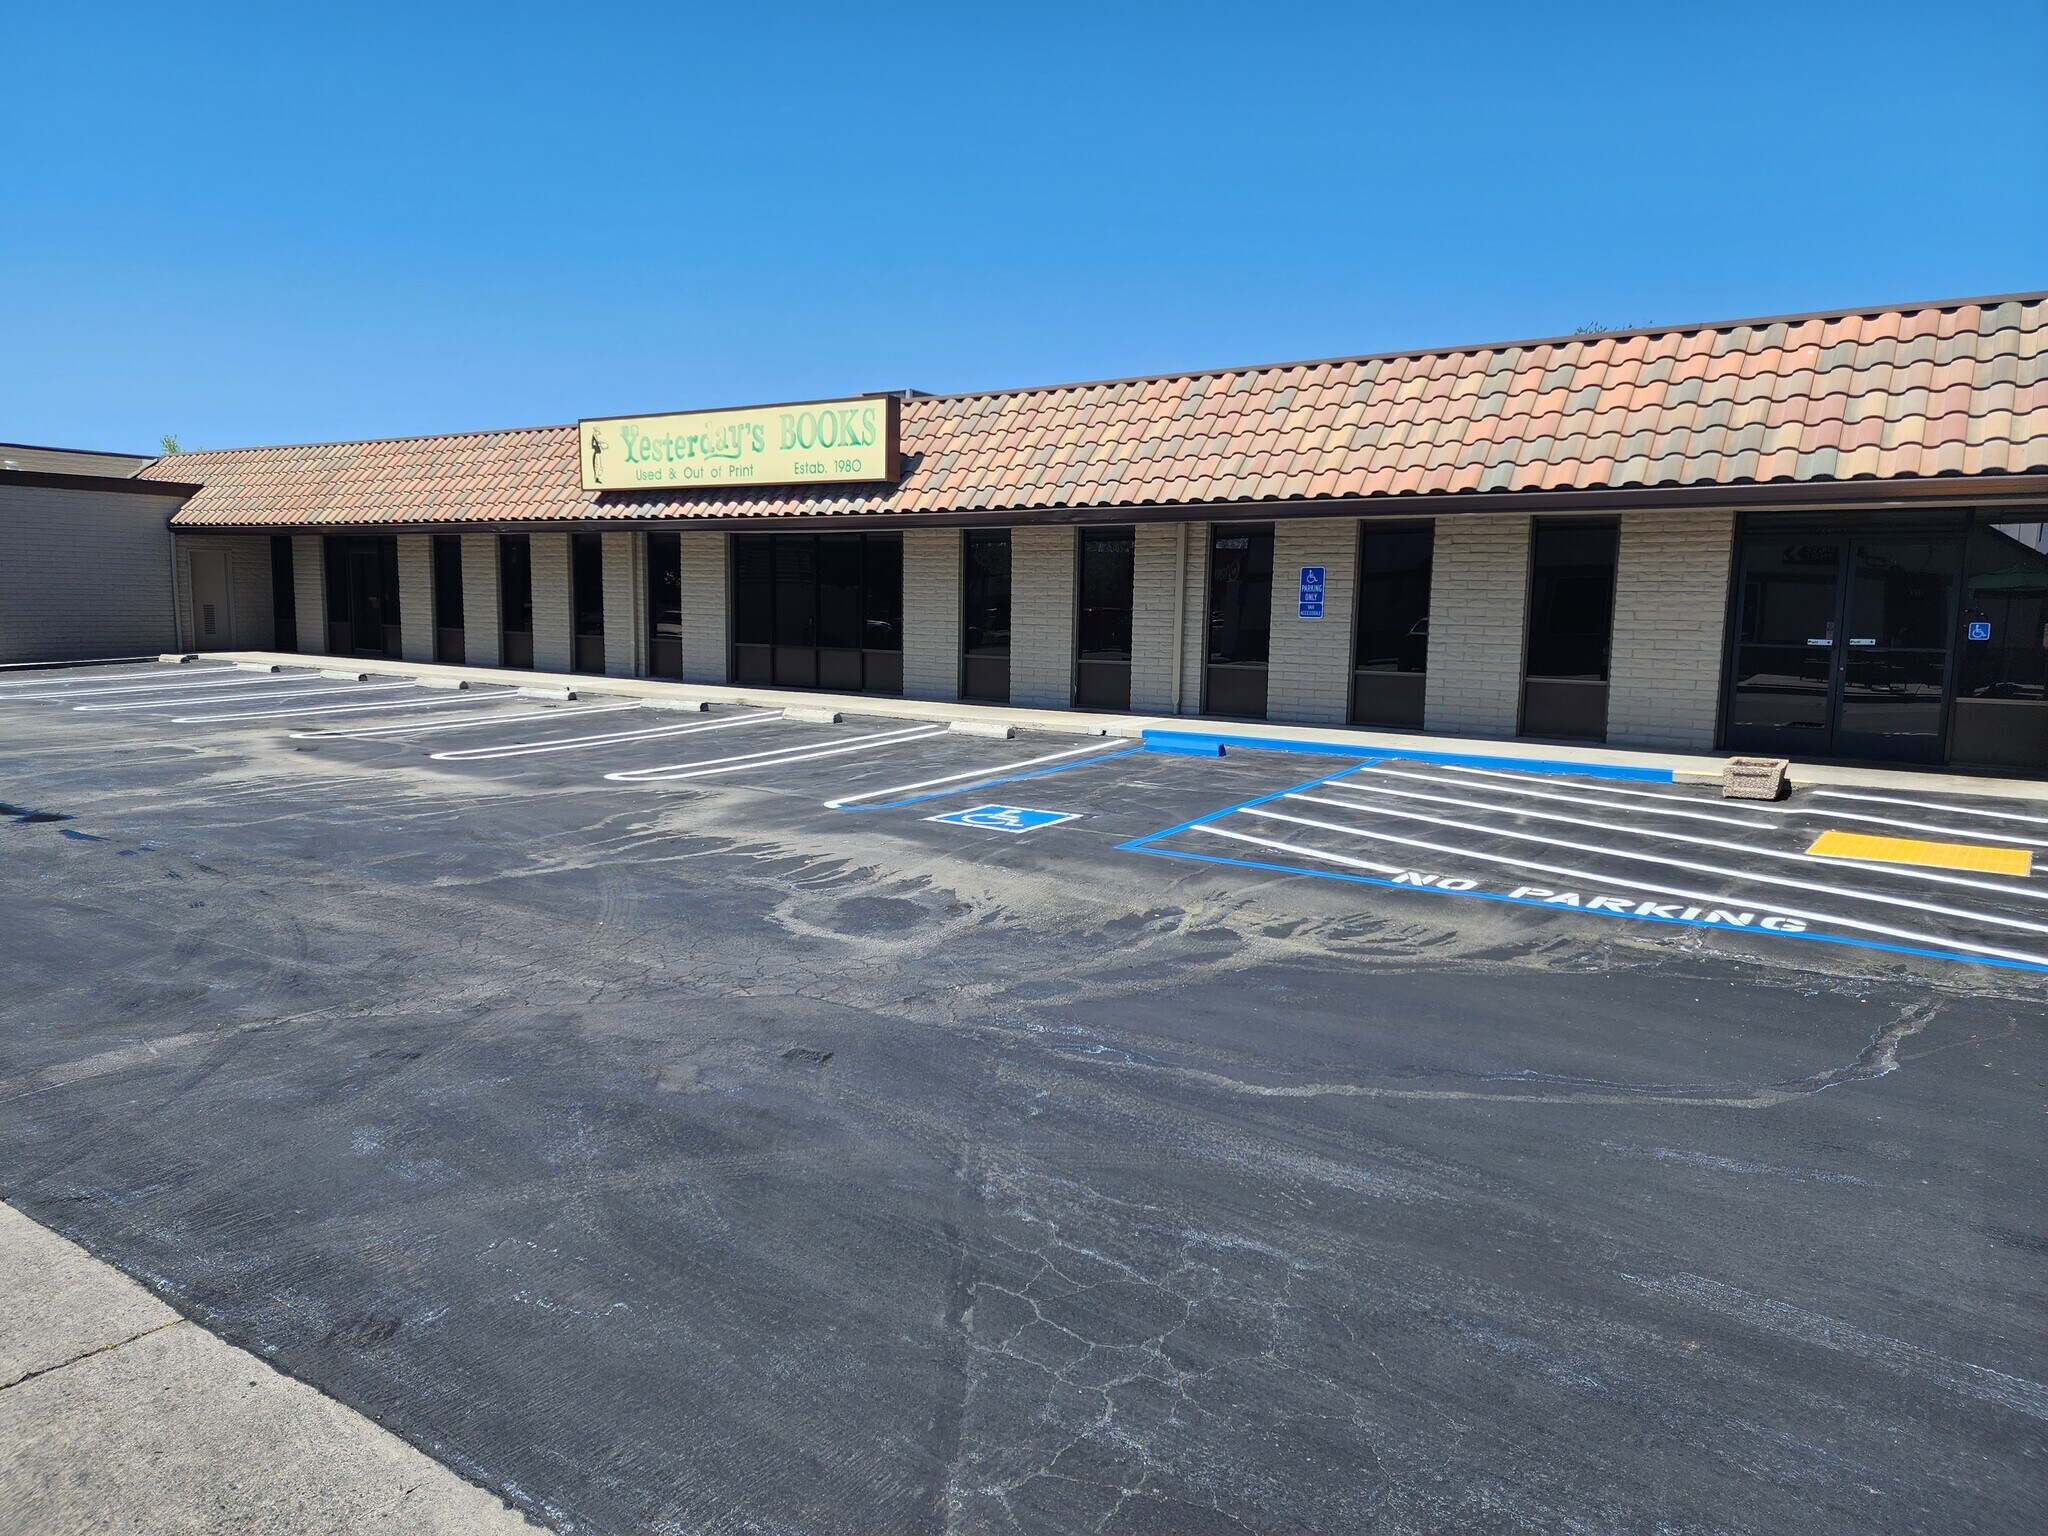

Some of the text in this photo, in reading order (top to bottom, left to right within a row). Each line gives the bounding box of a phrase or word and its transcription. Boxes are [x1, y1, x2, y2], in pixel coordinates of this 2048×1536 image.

[620, 407, 877, 463] Yesterday's BOOKS
[636, 464, 754, 480] Used & Out of Print
[794, 458, 862, 475] Estab. 1980
[1395, 872, 1807, 933] NO PARKING
